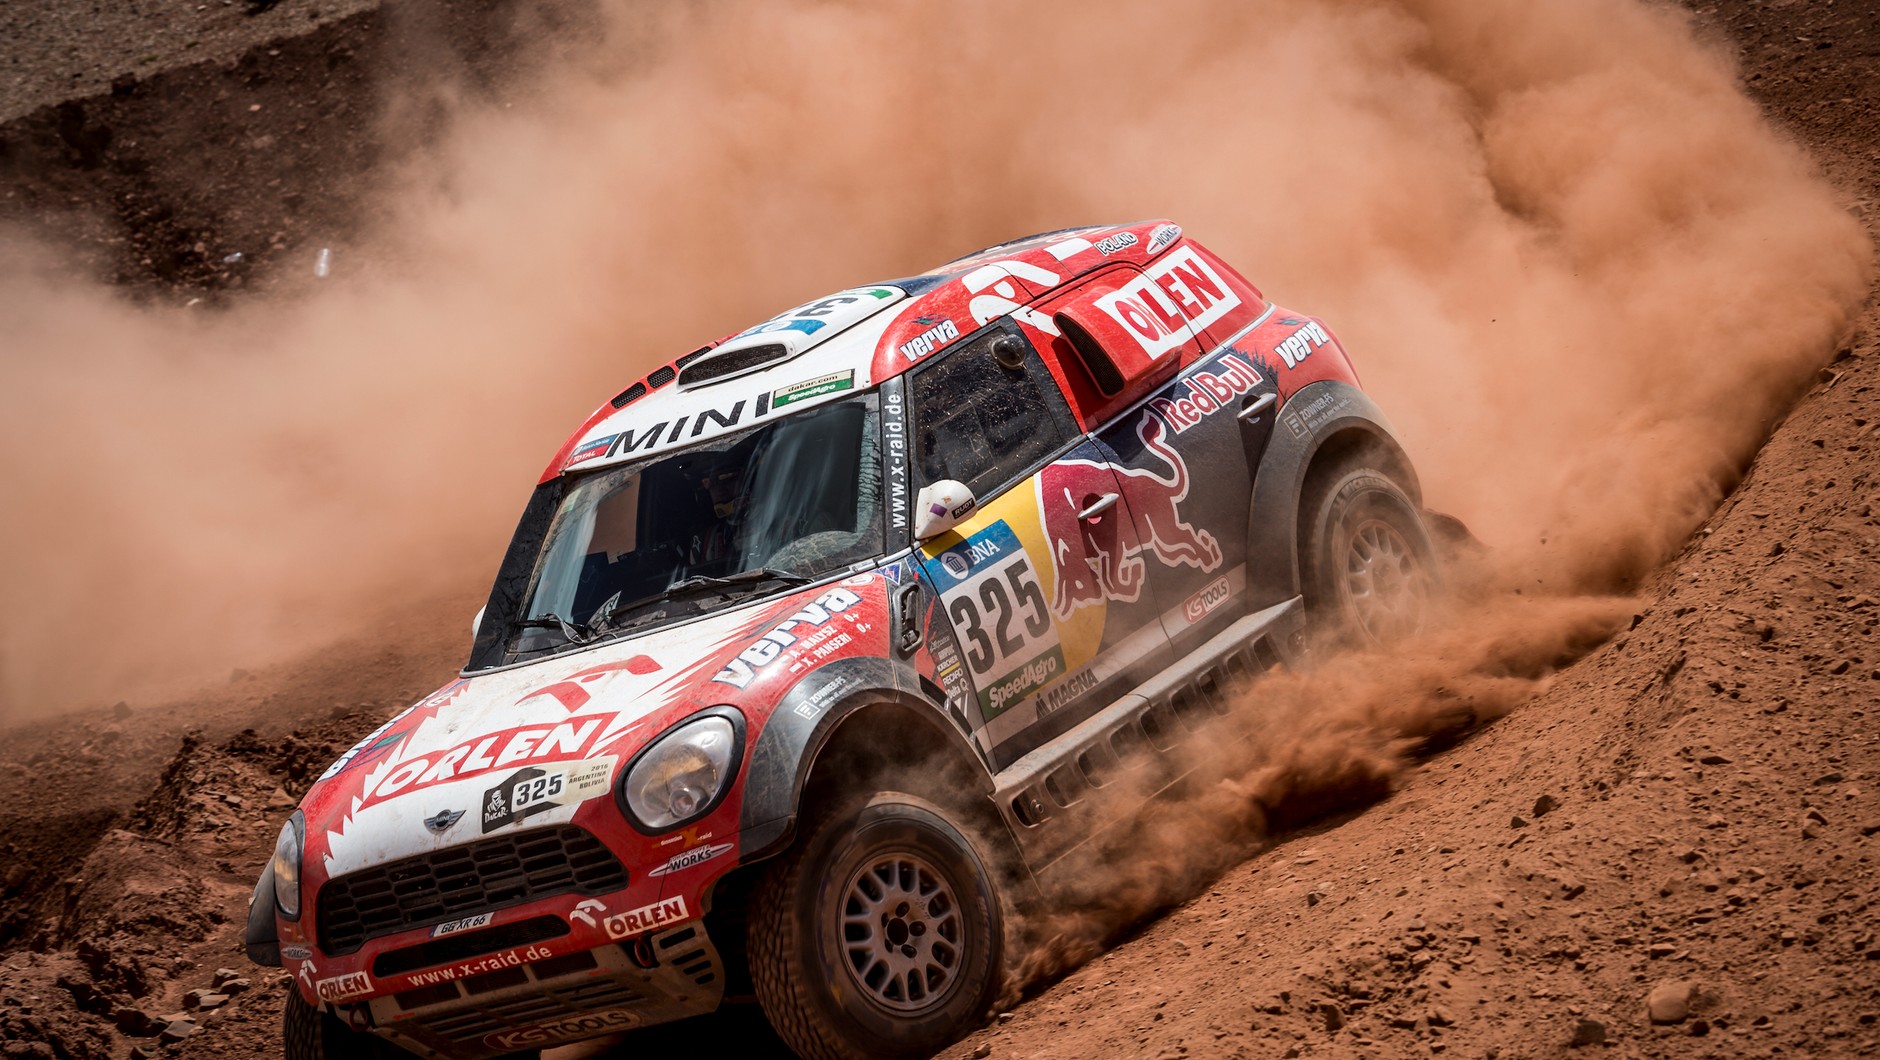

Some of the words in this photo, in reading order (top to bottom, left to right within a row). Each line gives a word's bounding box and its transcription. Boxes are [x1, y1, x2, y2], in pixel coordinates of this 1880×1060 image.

[1095, 233, 1137, 255] POLAND
[898, 319, 960, 362] verva
[1274, 321, 1329, 370] verva
[787, 384, 836, 401] SpeedAgro
[788, 375, 838, 393] dakar.com
[1150, 379, 1219, 434] Red
[1193, 354, 1263, 406] Bull
[605, 391, 770, 458] MINI
[573, 450, 596, 463] TOTAL
[885, 394, 906, 528] www.x-raid.de
[964, 539, 1001, 565] BNA
[1200, 583, 1228, 606] TOOLS
[950, 558, 1050, 674] 325
[711, 587, 863, 690] verva
[813, 632, 852, 659] PANSERI
[943, 668, 963, 686] RECARO
[989, 657, 1056, 708] SpeedAgro
[1048, 669, 1099, 711] MAGNA
[376, 719, 603, 796] ORLEN
[516, 774, 563, 806] 325
[568, 771, 607, 784] ARGENTINA
[579, 779, 605, 789] BOLIVIA
[484, 807, 507, 823] DAKAR
[670, 849, 711, 870] WORKS
[441, 920, 456, 933] GG
[457, 918, 470, 930] XR
[473, 915, 486, 926] 66
[609, 901, 682, 935] ORLEN
[408, 946, 552, 986] www.x-raid.de
[319, 975, 368, 999] ORLEN
[541, 1013, 631, 1035] TOOLS
